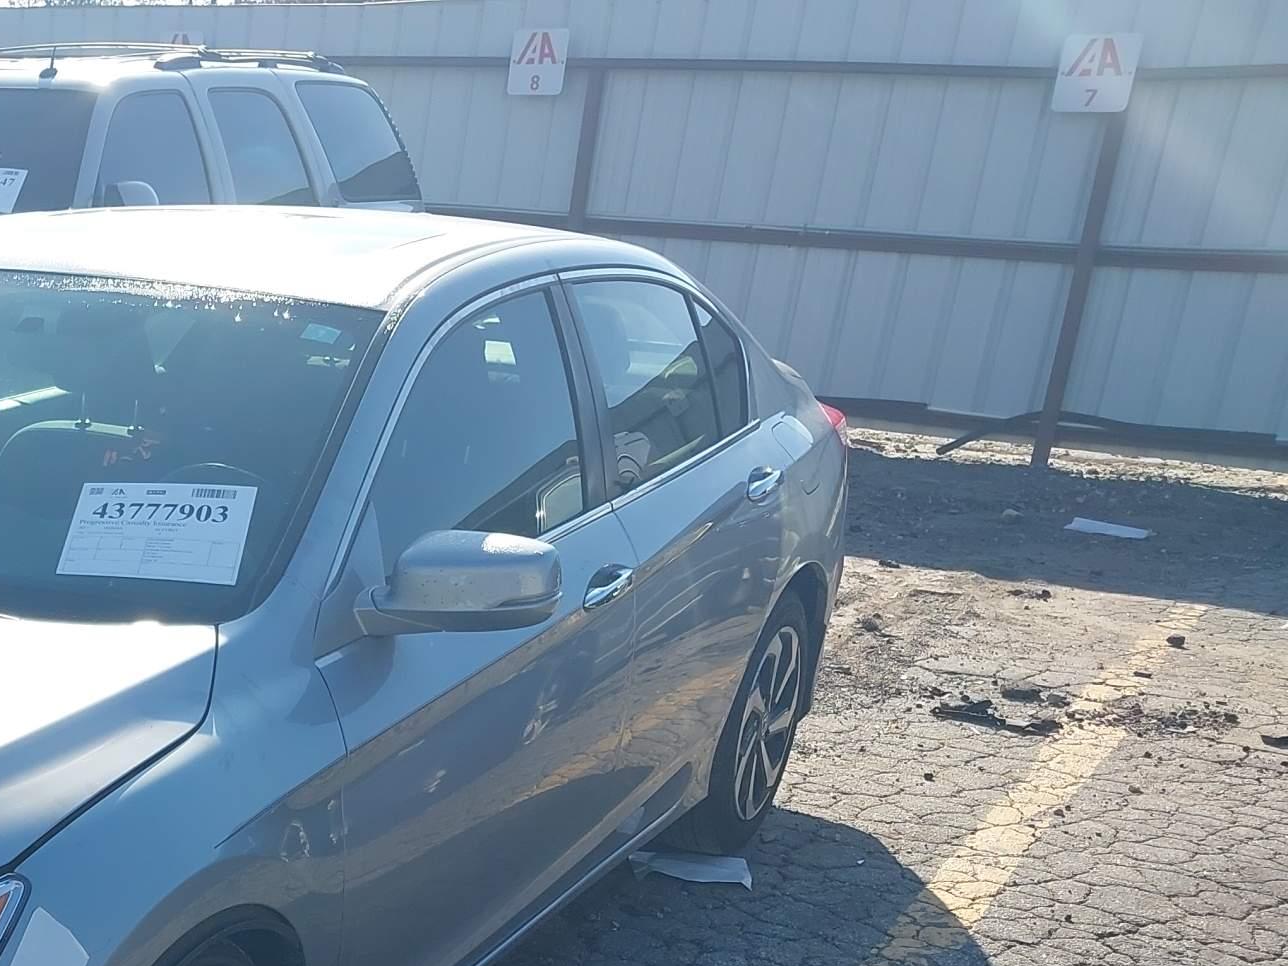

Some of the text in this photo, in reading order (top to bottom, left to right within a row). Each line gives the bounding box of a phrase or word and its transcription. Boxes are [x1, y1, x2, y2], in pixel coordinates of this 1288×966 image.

[530, 75, 540, 90] 8
[1084, 89, 1098, 107] 7
[92, 502, 229, 523] 43777903
